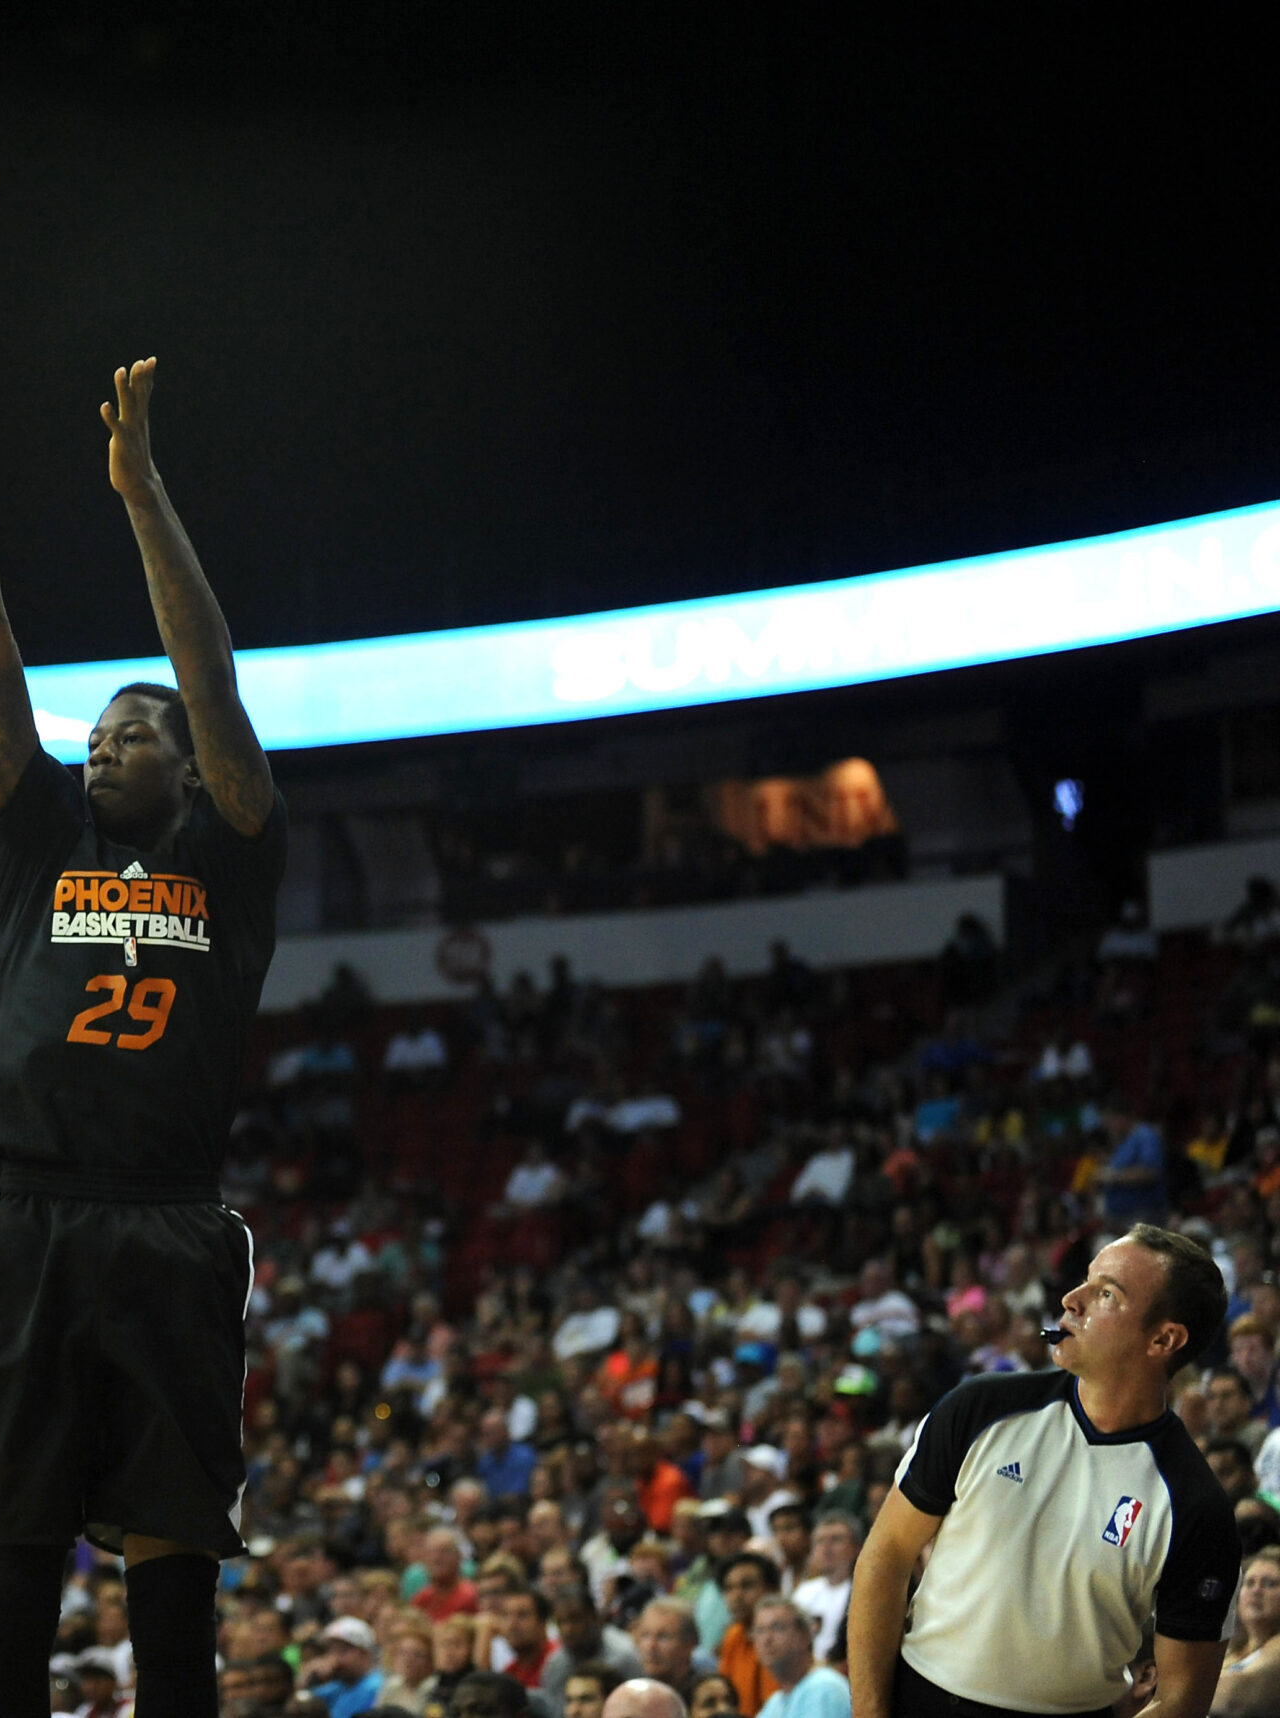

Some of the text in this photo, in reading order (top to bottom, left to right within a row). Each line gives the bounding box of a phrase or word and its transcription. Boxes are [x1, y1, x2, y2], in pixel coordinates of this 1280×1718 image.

[119, 871, 149, 880] adidas
[53, 878, 211, 920] PHOENIX
[51, 911, 211, 945] BASKETBALL
[66, 974, 177, 1051] 29
[1103, 1530, 1119, 1543] NBA
